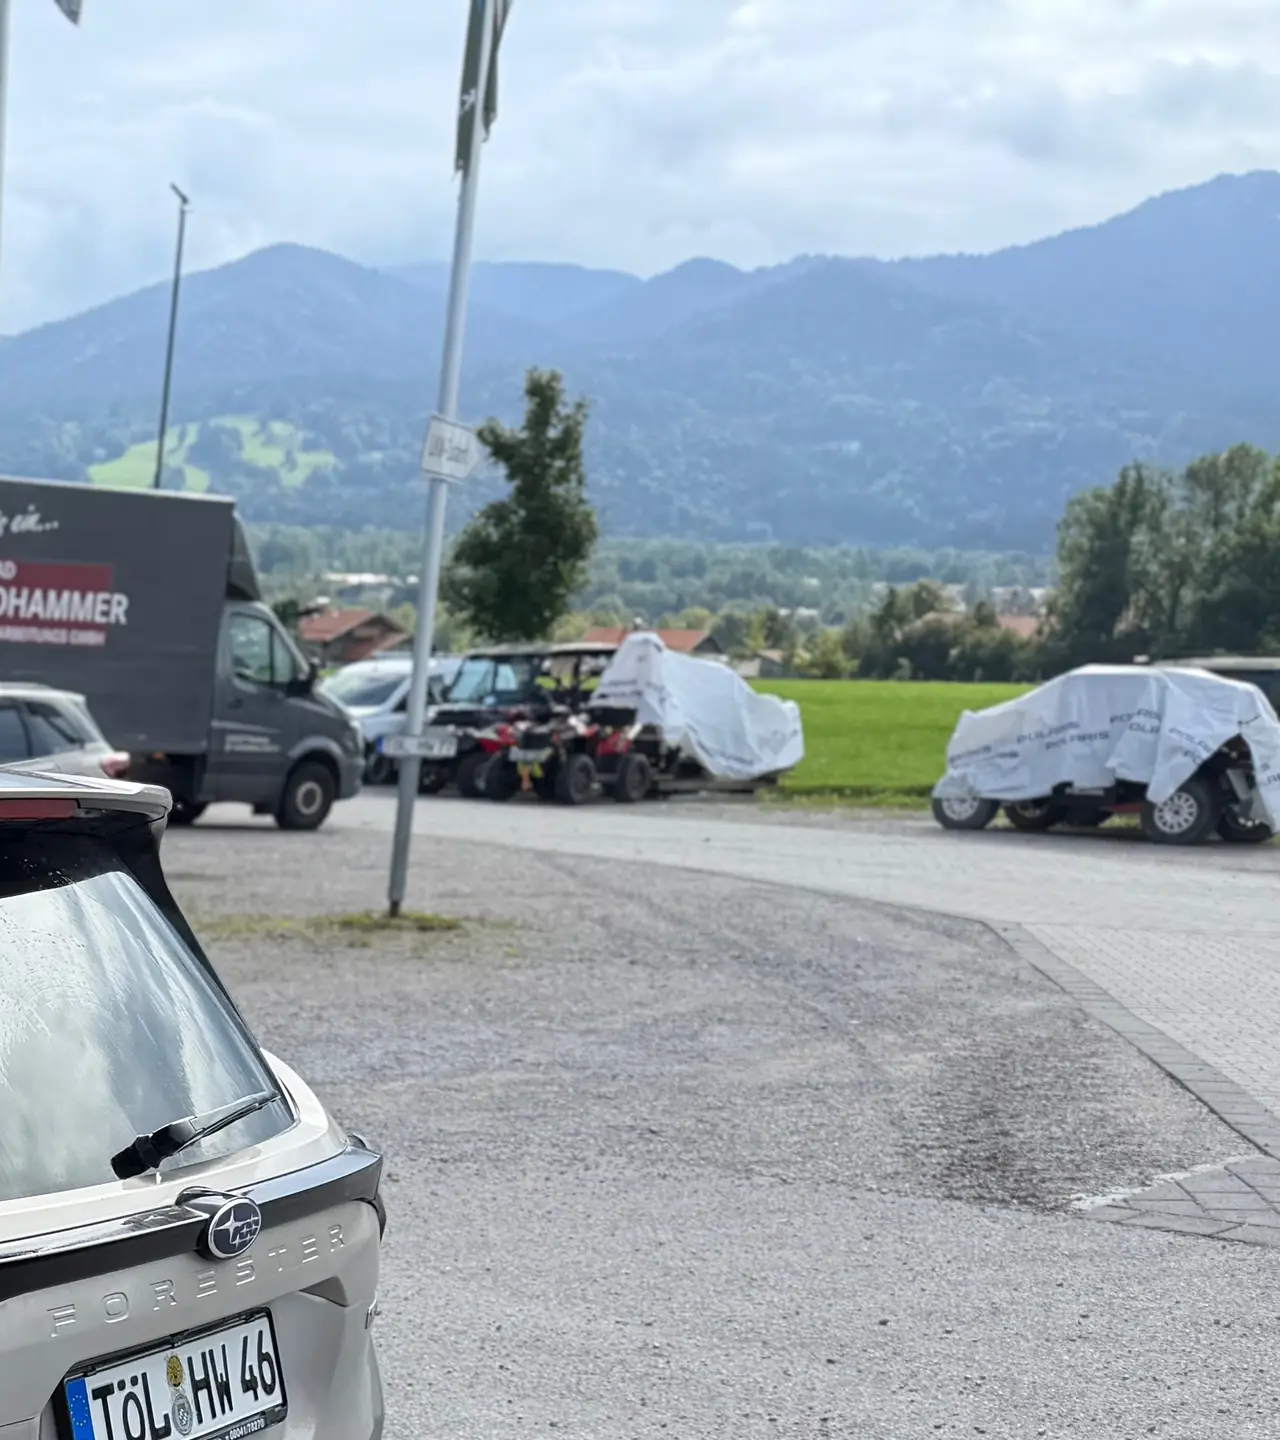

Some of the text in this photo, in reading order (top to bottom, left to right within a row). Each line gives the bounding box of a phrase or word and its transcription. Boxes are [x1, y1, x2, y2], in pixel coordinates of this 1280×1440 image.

[47, 1223, 346, 1338] FORESTER
[186, 1343, 234, 1425] HW
[240, 1329, 277, 1402] 46
